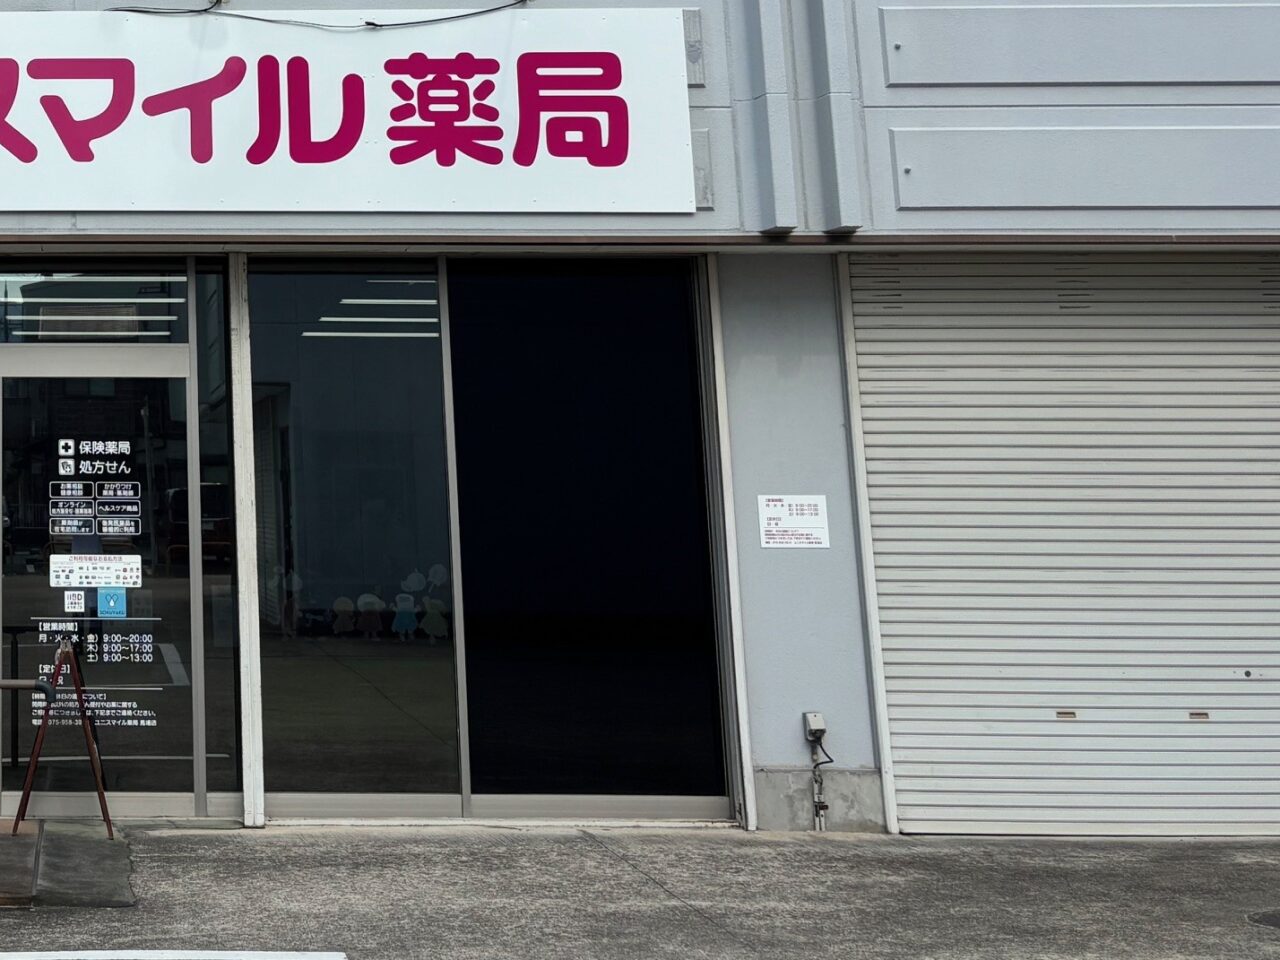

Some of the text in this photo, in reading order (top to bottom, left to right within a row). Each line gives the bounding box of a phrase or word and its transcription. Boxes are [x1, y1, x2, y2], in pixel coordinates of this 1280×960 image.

[79, 441, 131, 455] 保険薬局
[79, 460, 131, 474] 処方せん
